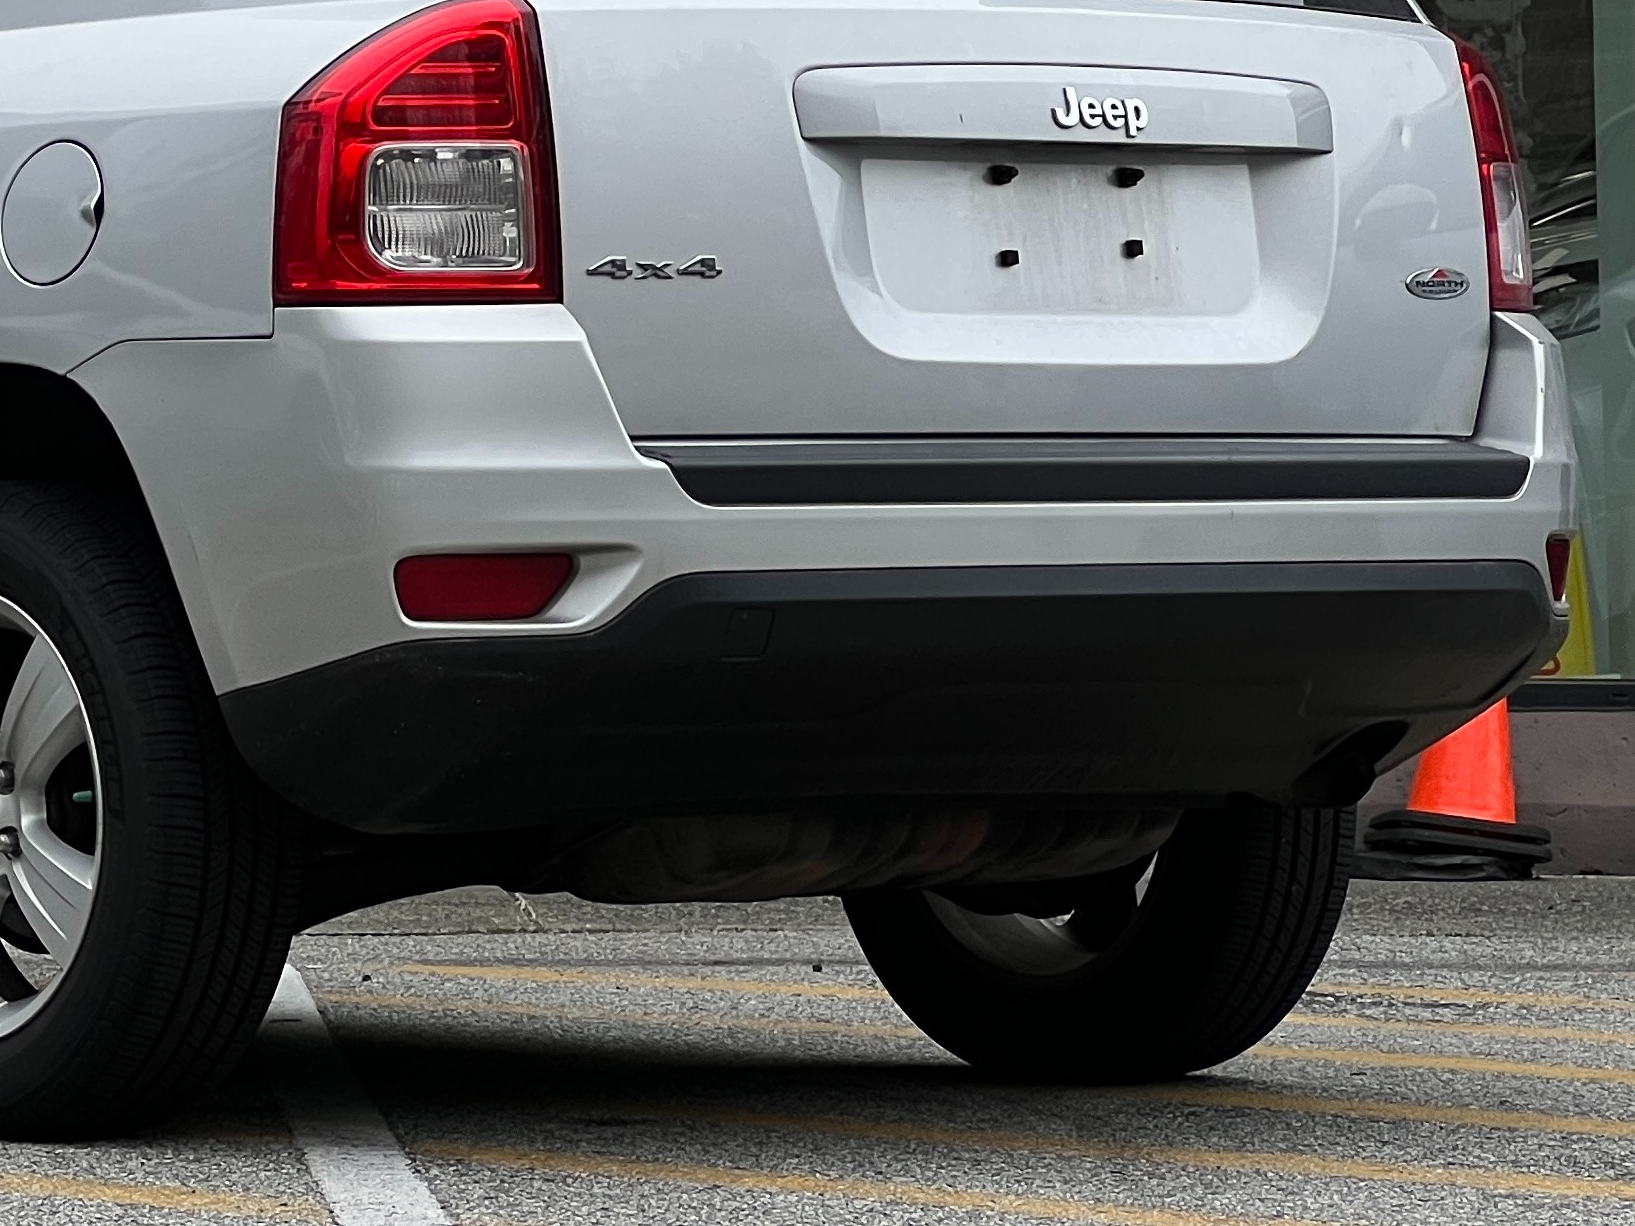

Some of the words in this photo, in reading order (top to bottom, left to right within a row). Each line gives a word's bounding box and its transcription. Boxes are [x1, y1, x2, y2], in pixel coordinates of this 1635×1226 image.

[1051, 86, 1149, 138] Jeep
[586, 255, 723, 280] 4x4
[1415, 280, 1464, 288] NORTH
